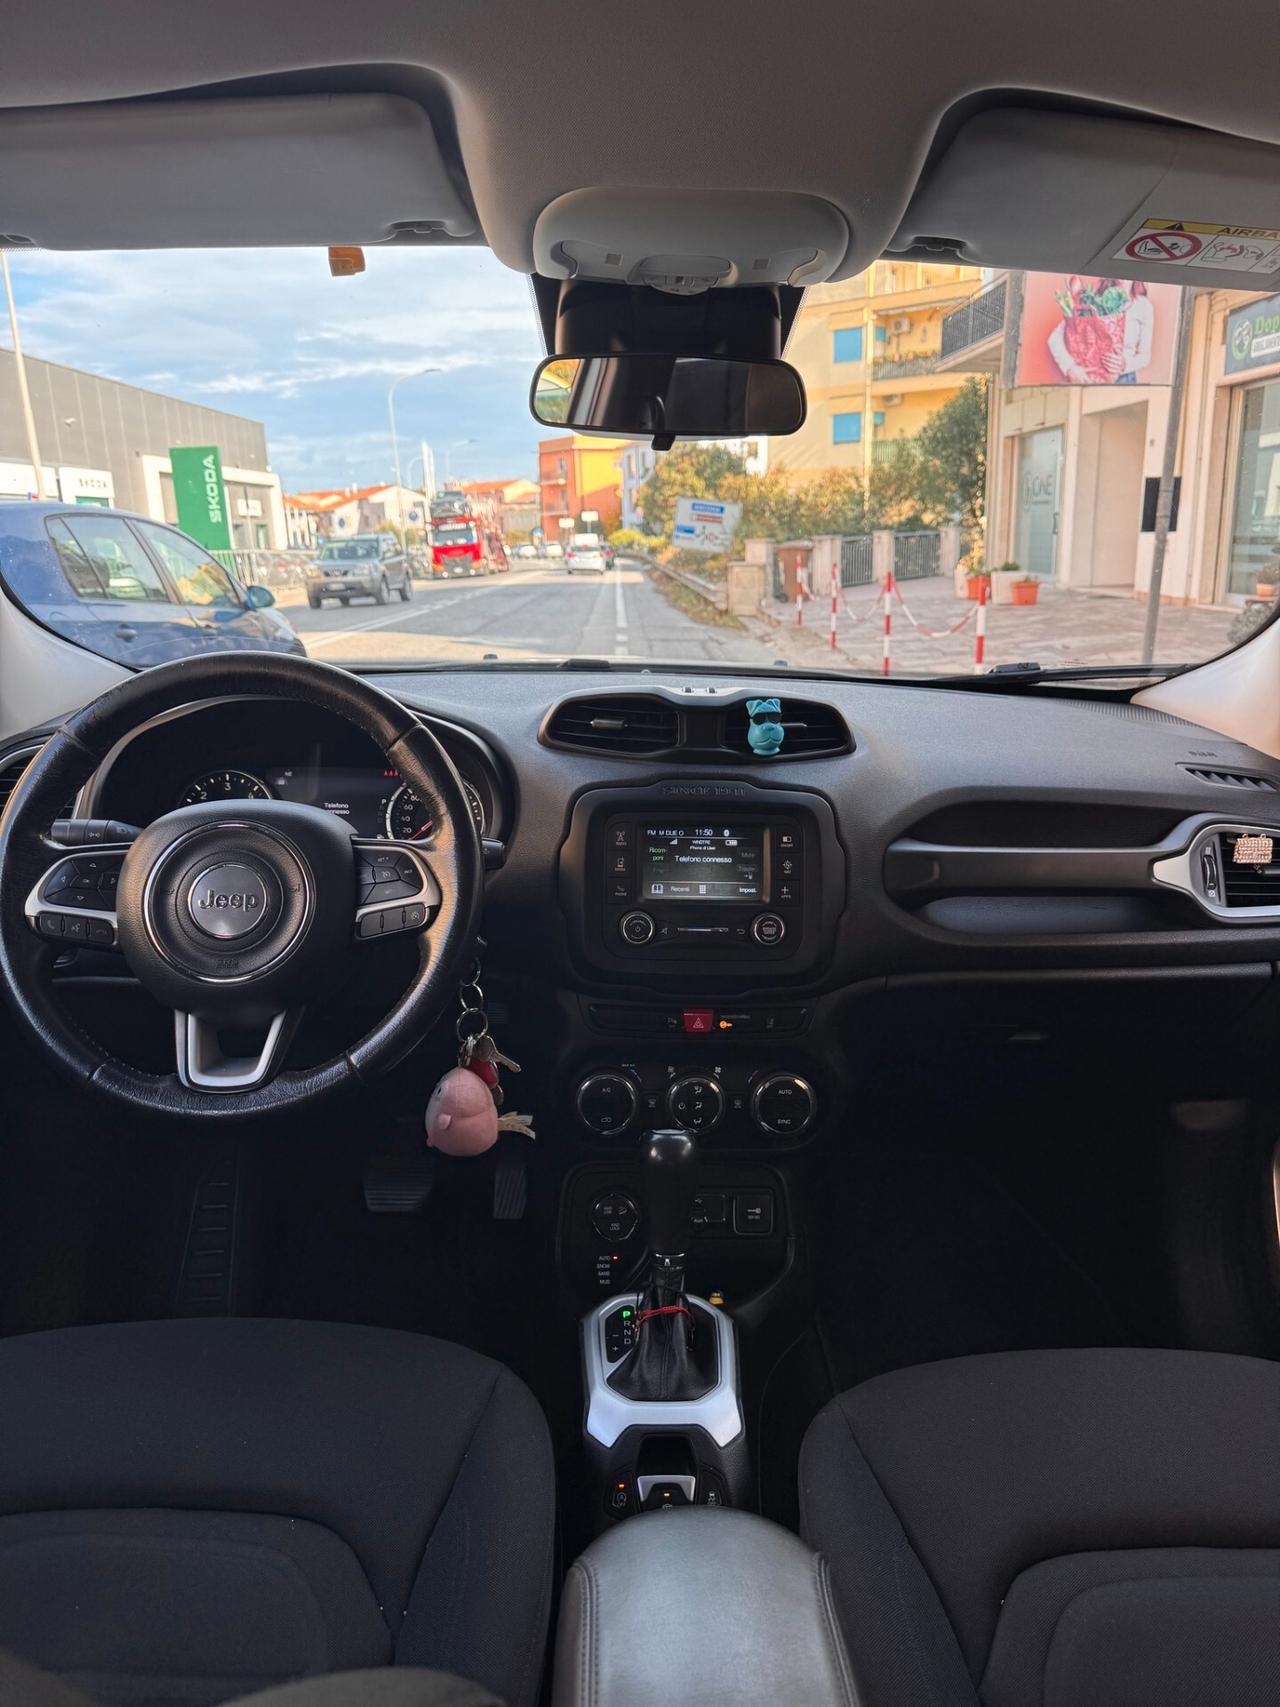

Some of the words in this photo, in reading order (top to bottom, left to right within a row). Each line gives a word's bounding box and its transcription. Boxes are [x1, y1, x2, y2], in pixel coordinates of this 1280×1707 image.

[1217, 227, 1279, 239] AIRBA
[200, 792, 207, 800] 2
[199, 889, 260, 912] Jeep
[622, 1310, 631, 1319] P
